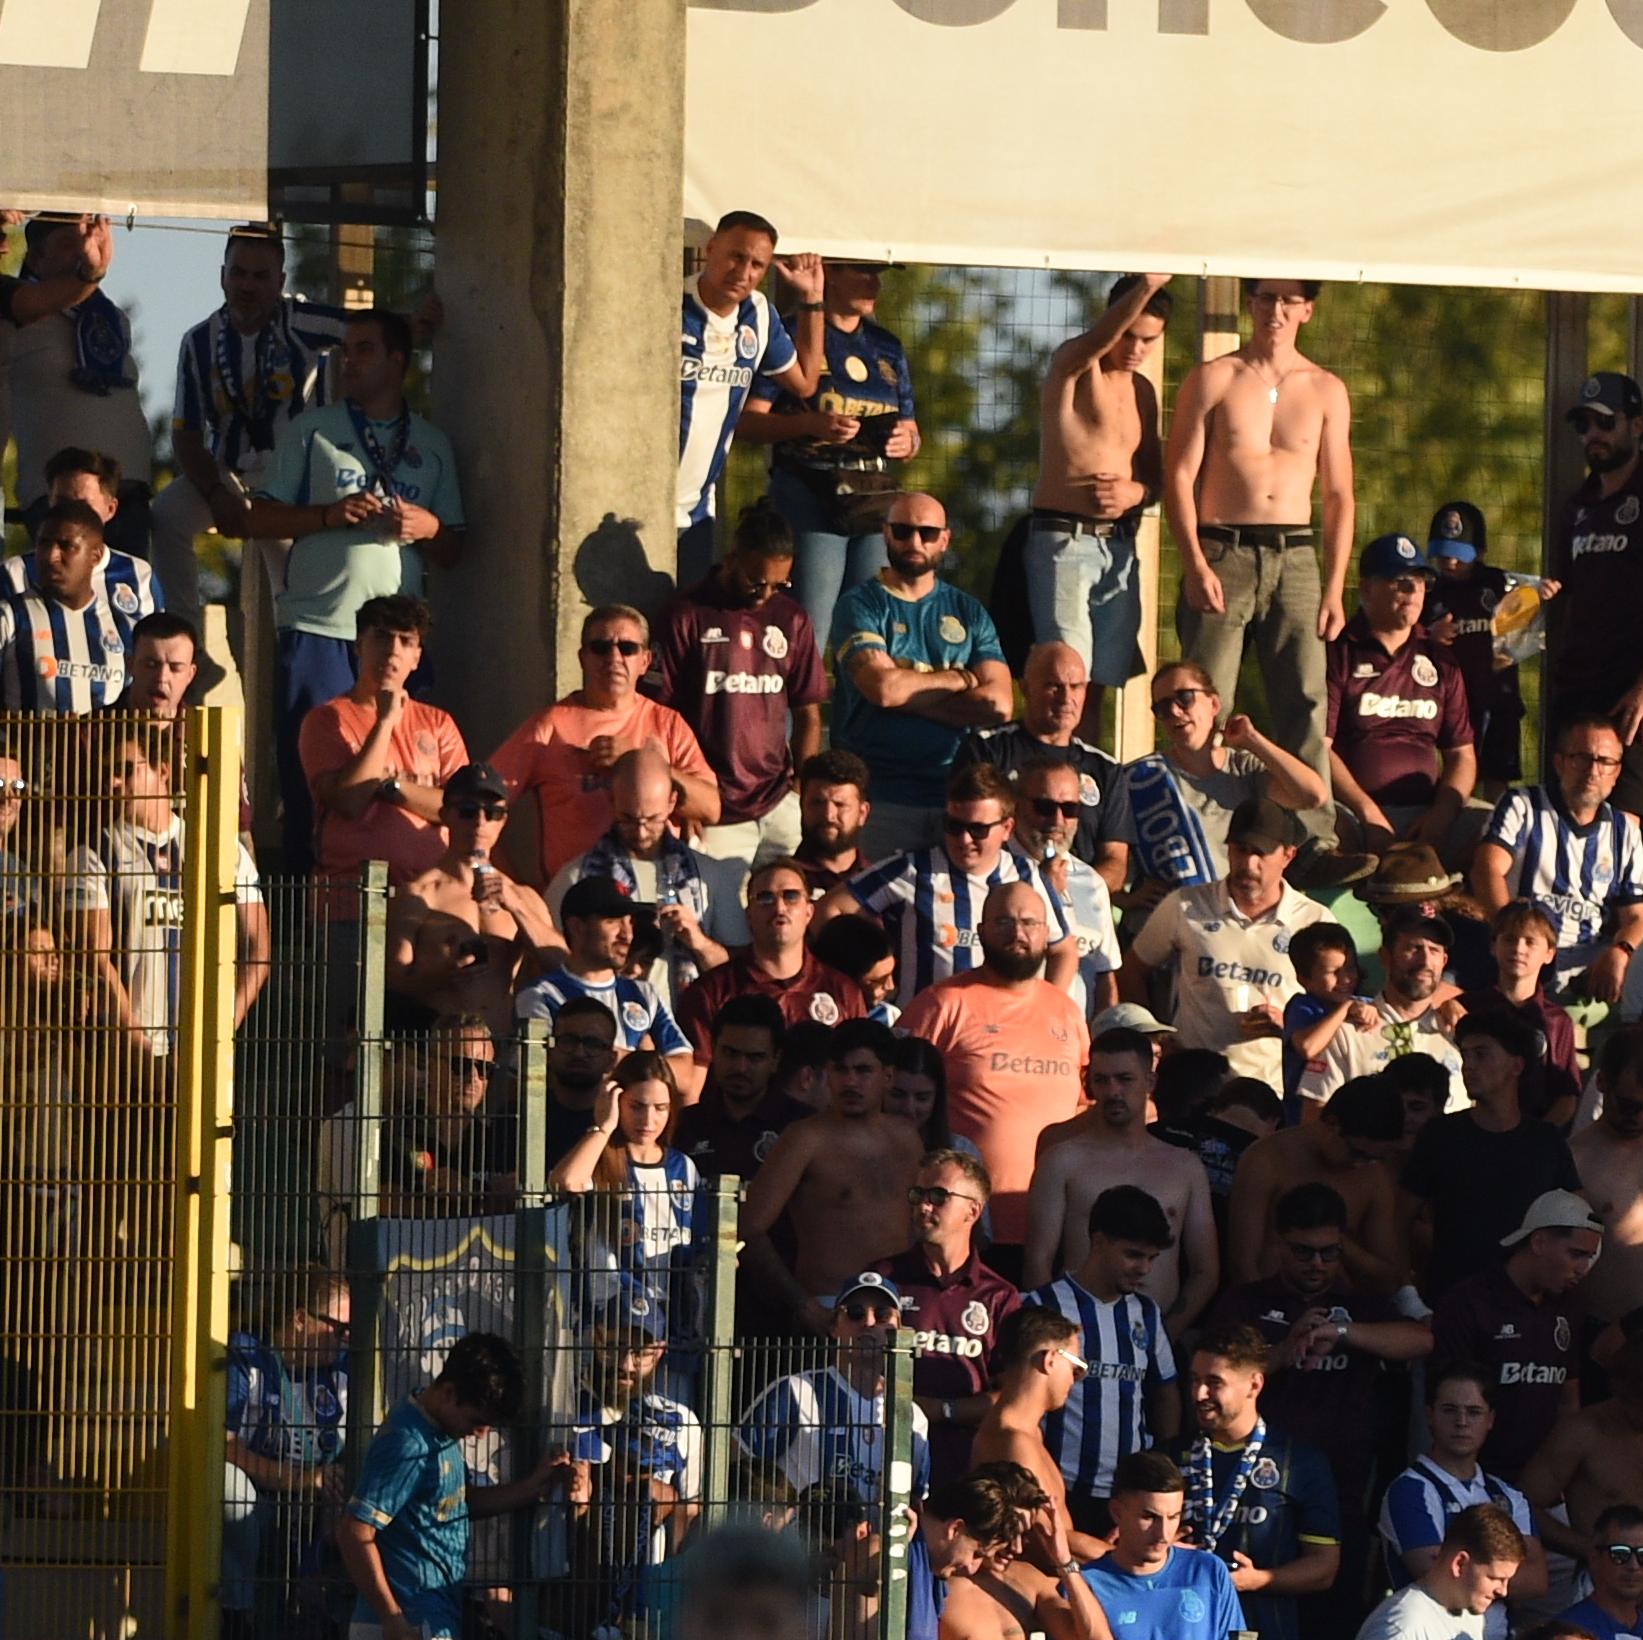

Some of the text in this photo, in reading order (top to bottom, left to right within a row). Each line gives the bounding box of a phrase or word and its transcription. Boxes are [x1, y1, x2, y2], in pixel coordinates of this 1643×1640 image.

[680, 356, 752, 387] Betano
[58, 659, 125, 686] BETANO
[705, 669, 784, 694] Betano
[1358, 691, 1438, 720] Betano
[1197, 956, 1283, 988] Betano
[990, 1051, 1071, 1077] Betano
[912, 1331, 984, 1358] etano
[1499, 1362, 1568, 1386] Betano
